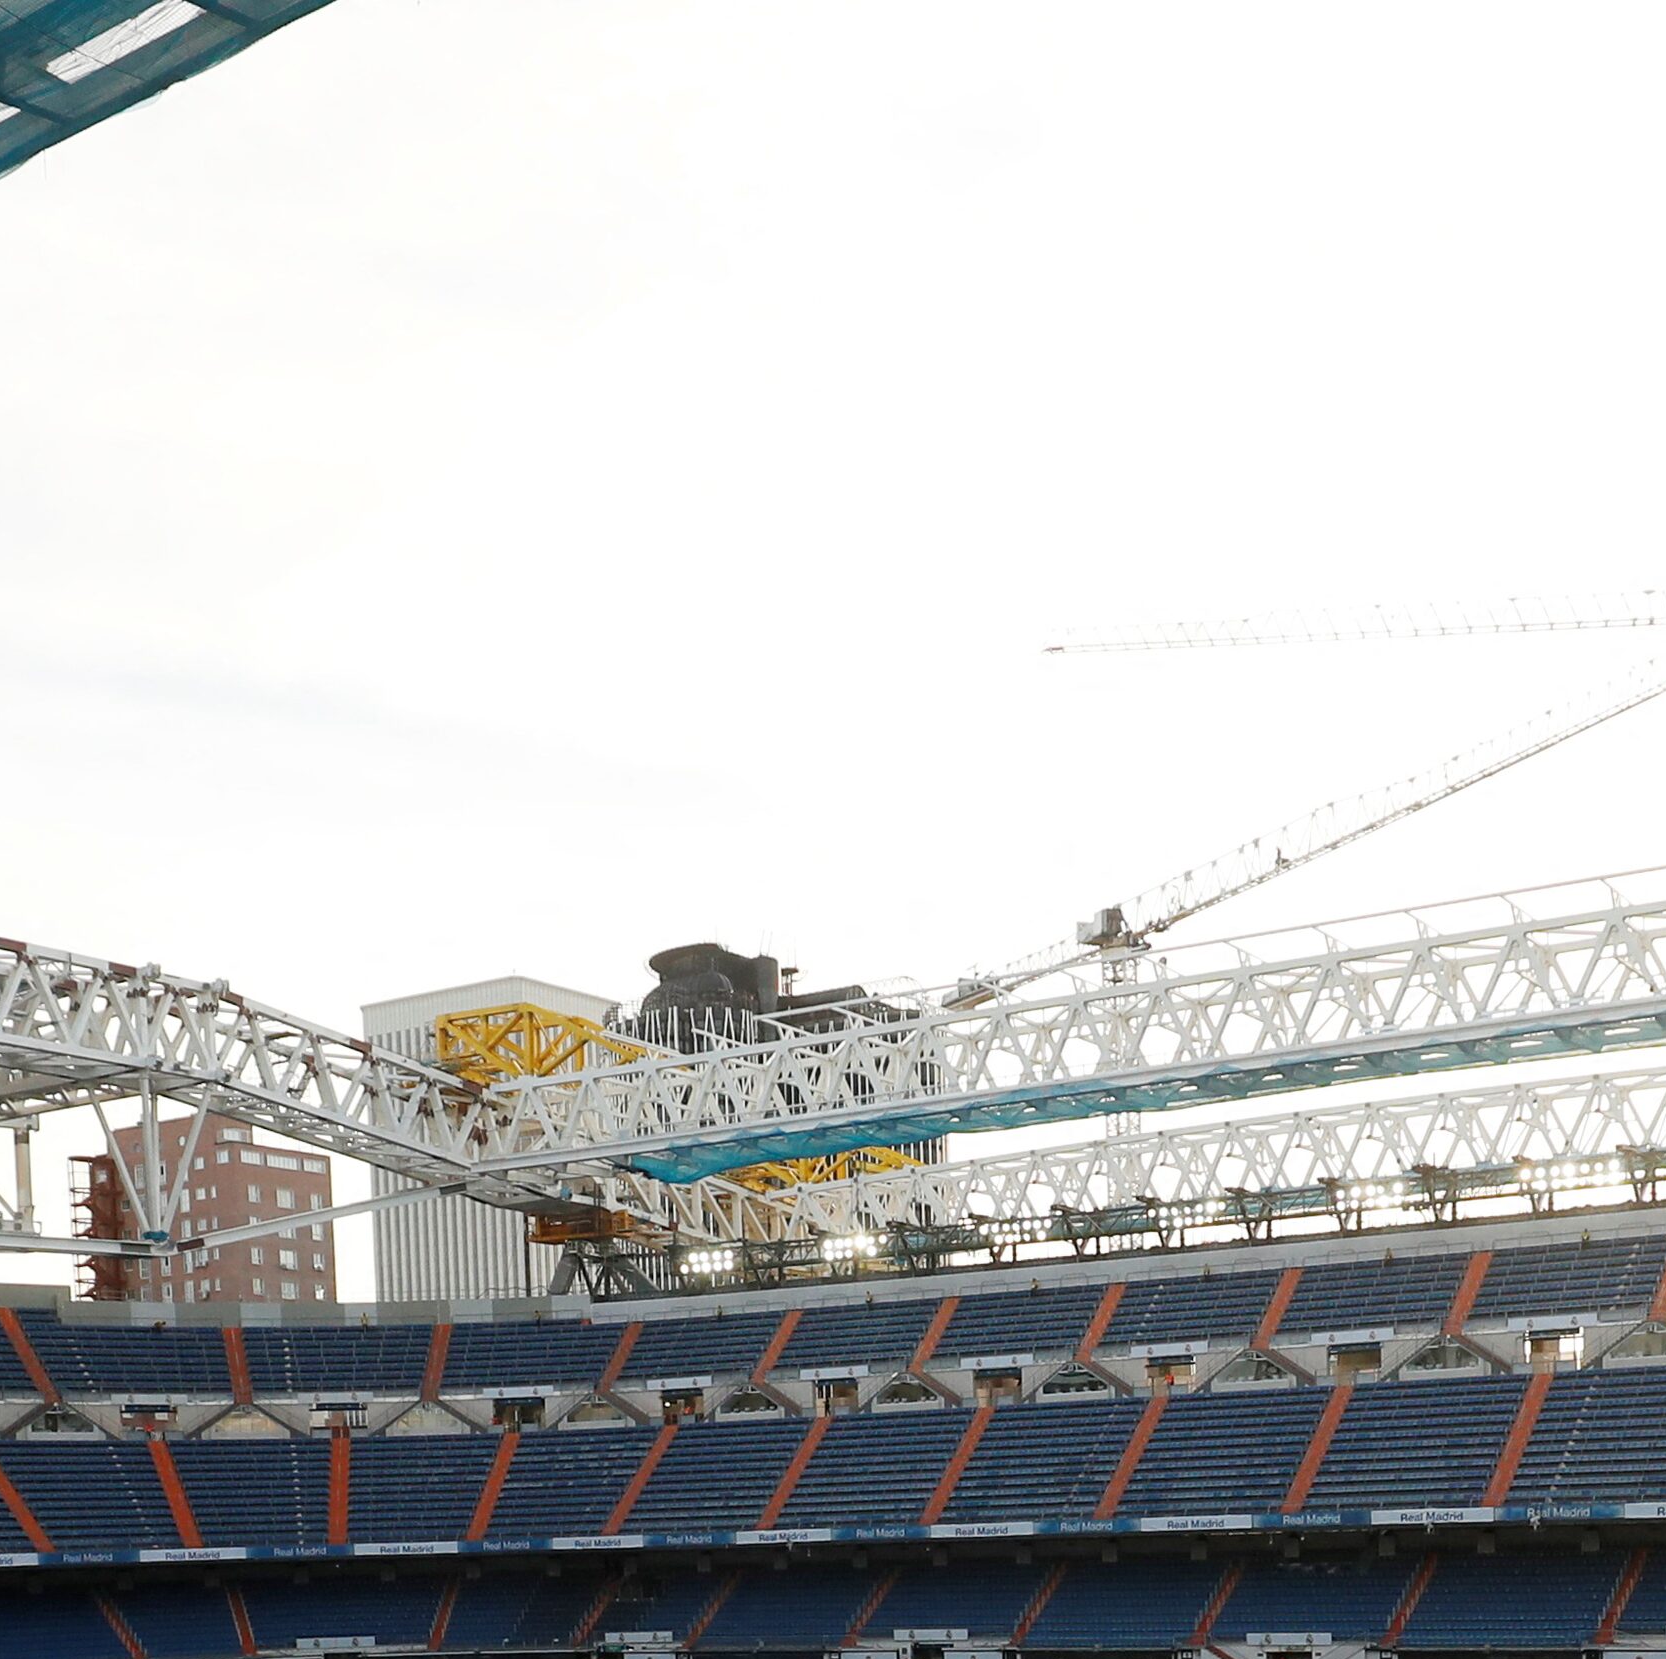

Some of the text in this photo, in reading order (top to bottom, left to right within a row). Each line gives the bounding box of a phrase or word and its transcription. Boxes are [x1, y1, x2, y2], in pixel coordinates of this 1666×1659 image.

[1554, 1506, 1590, 1518] Madrid
[1283, 1514, 1341, 1524] Real Madrid
[1401, 1512, 1463, 1523] Real Madrid
[1060, 1522, 1113, 1532] Real Madrid
[1167, 1520, 1225, 1530] Real Madrid
[856, 1528, 905, 1538] Real Madrid
[955, 1526, 1009, 1536] Real Madrid
[667, 1534, 713, 1544] Real Madrid
[759, 1532, 777, 1542] Real
[483, 1540, 530, 1550] Real Madrid
[575, 1538, 622, 1548] Real Madrid
[274, 1547, 327, 1556] Real Madrid
[380, 1544, 433, 1554] Real Madrid
[63, 1552, 113, 1562] Real Madrid
[165, 1550, 221, 1560] Real Madrid
